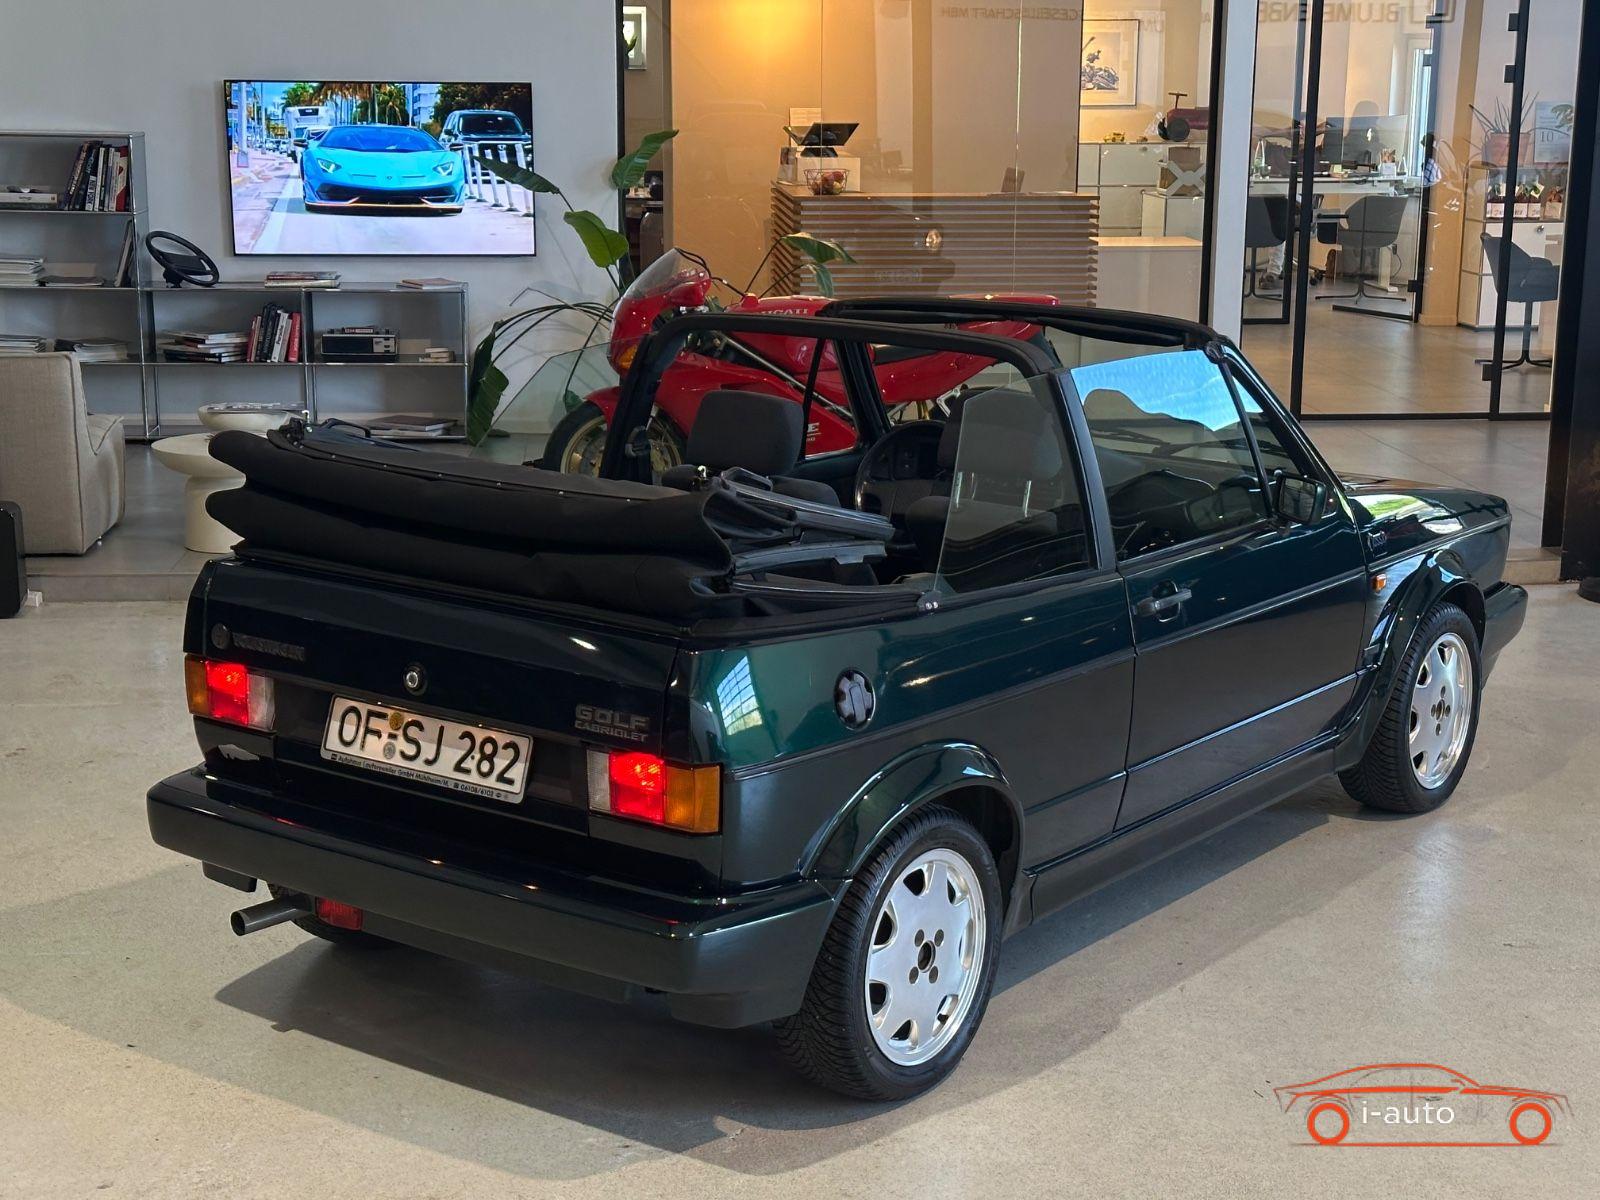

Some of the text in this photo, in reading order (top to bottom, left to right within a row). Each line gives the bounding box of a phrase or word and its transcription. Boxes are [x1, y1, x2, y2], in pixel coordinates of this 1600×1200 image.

[575, 703, 650, 730] GOLF
[574, 719, 649, 743] CABRIOLET
[453, 730, 520, 786] 282
